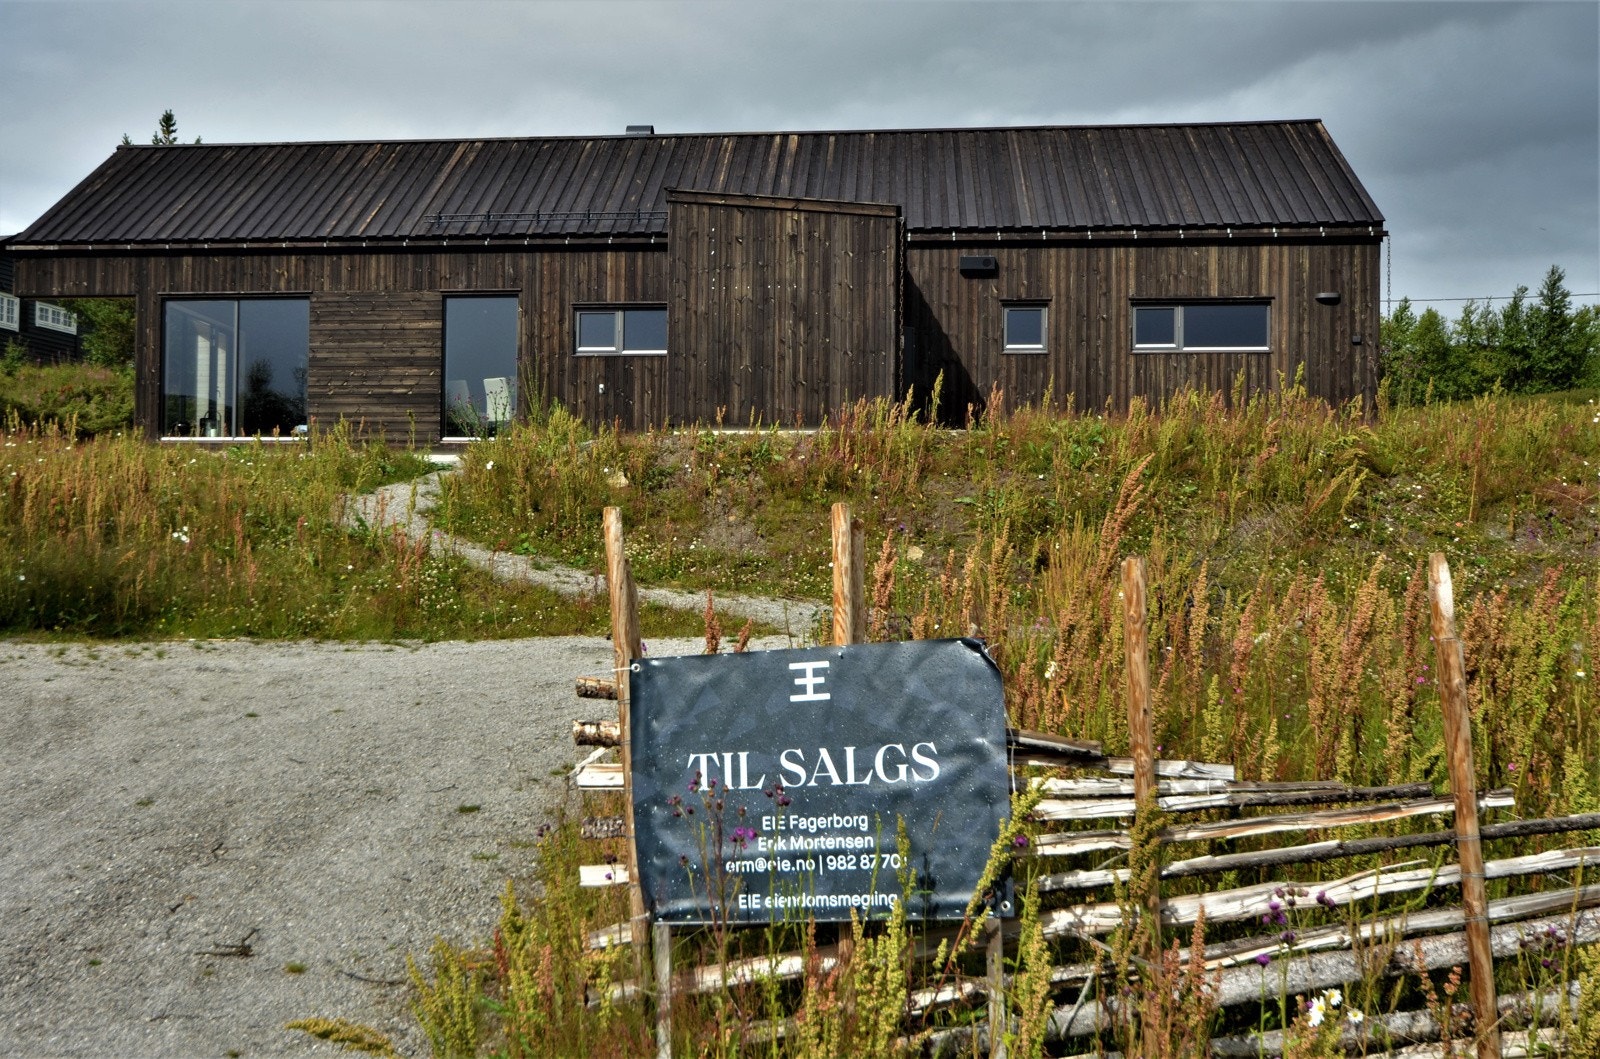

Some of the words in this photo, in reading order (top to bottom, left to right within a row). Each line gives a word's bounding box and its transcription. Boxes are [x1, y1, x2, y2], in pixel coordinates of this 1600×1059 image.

[688, 751, 766, 791] TIL
[779, 741, 941, 788] SALGS
[762, 815, 785, 830] EIE
[789, 814, 869, 832] Fagerborg
[758, 836, 787, 851] Erik
[790, 836, 874, 850] Mortensen
[827, 855, 857, 870] 982
[859, 855, 877, 869] 87
[881, 854, 908, 869] 70
[738, 894, 761, 908] EIE
[764, 892, 898, 909] eiendomsmegling
